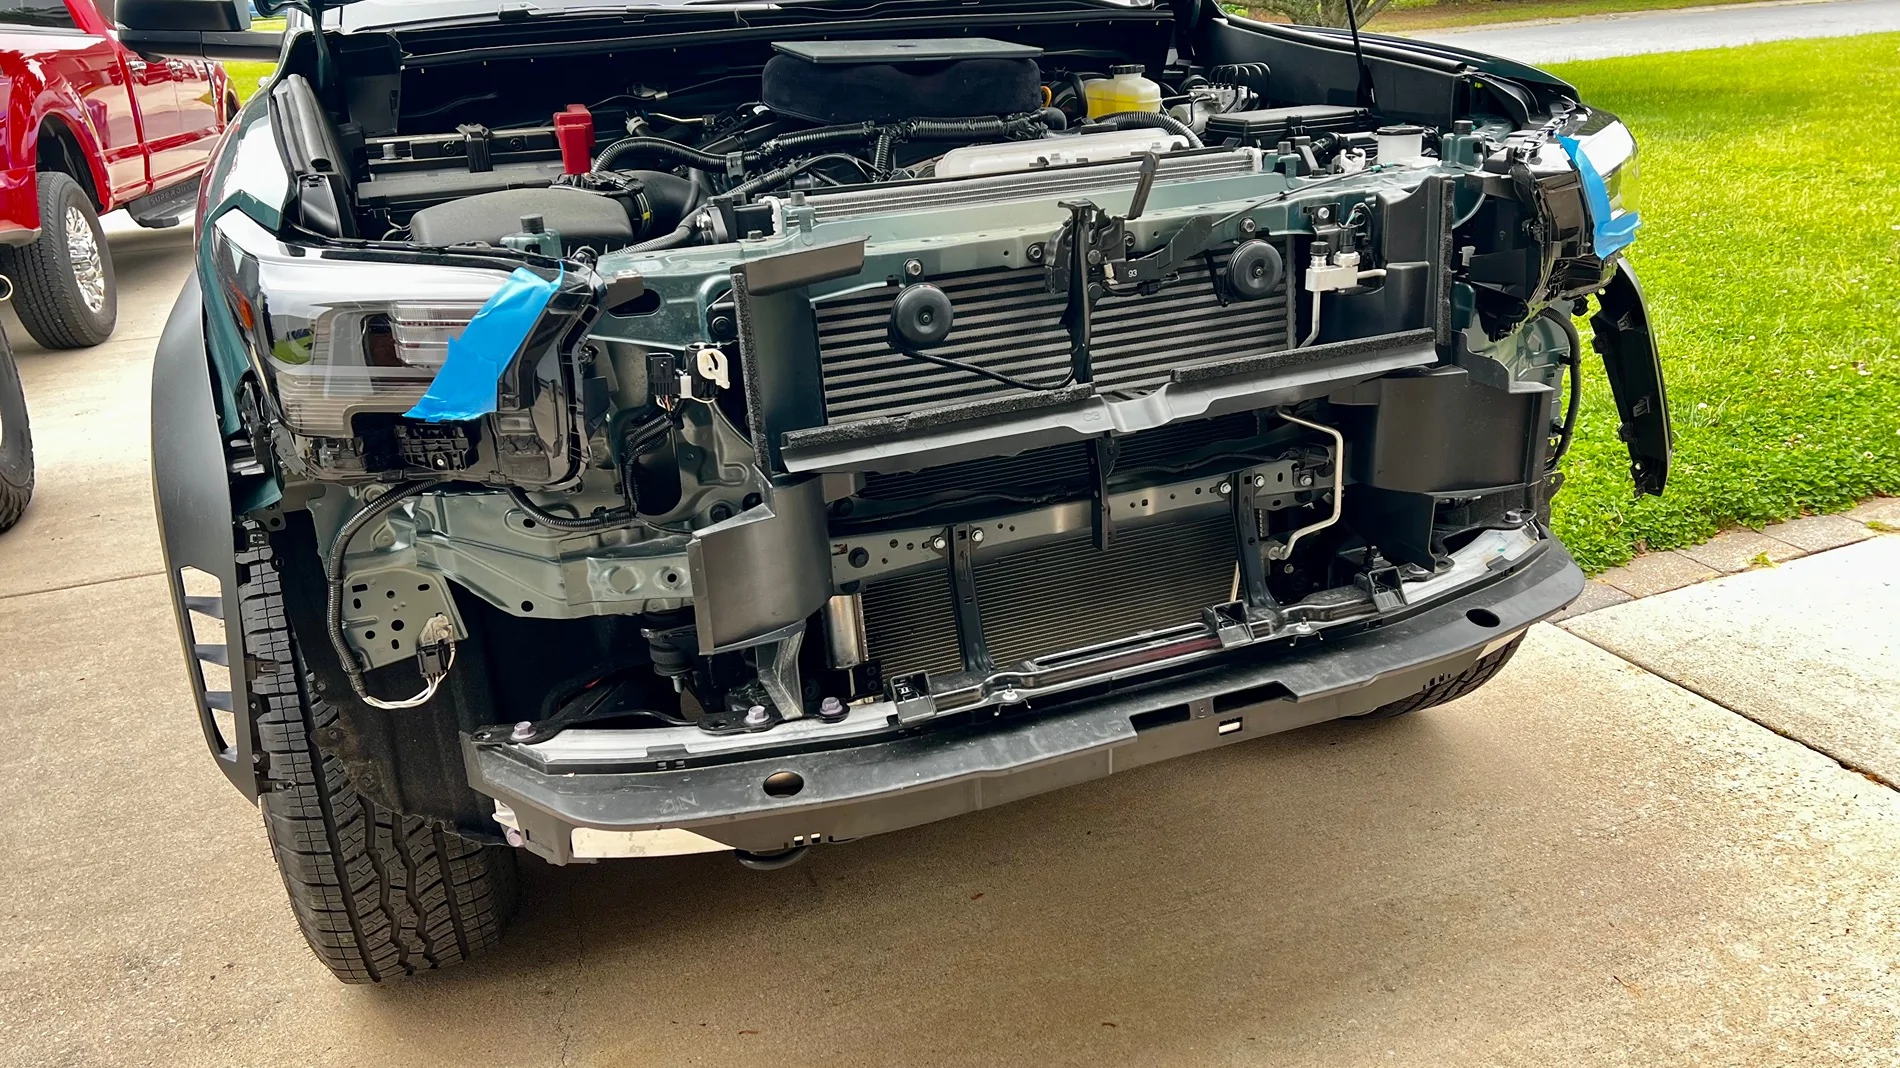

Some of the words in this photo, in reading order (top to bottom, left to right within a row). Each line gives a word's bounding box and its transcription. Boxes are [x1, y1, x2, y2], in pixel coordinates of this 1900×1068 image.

[149, 189, 175, 205] SUPER
[1128, 269, 1138, 278] 93
[1083, 411, 1100, 422] C3
